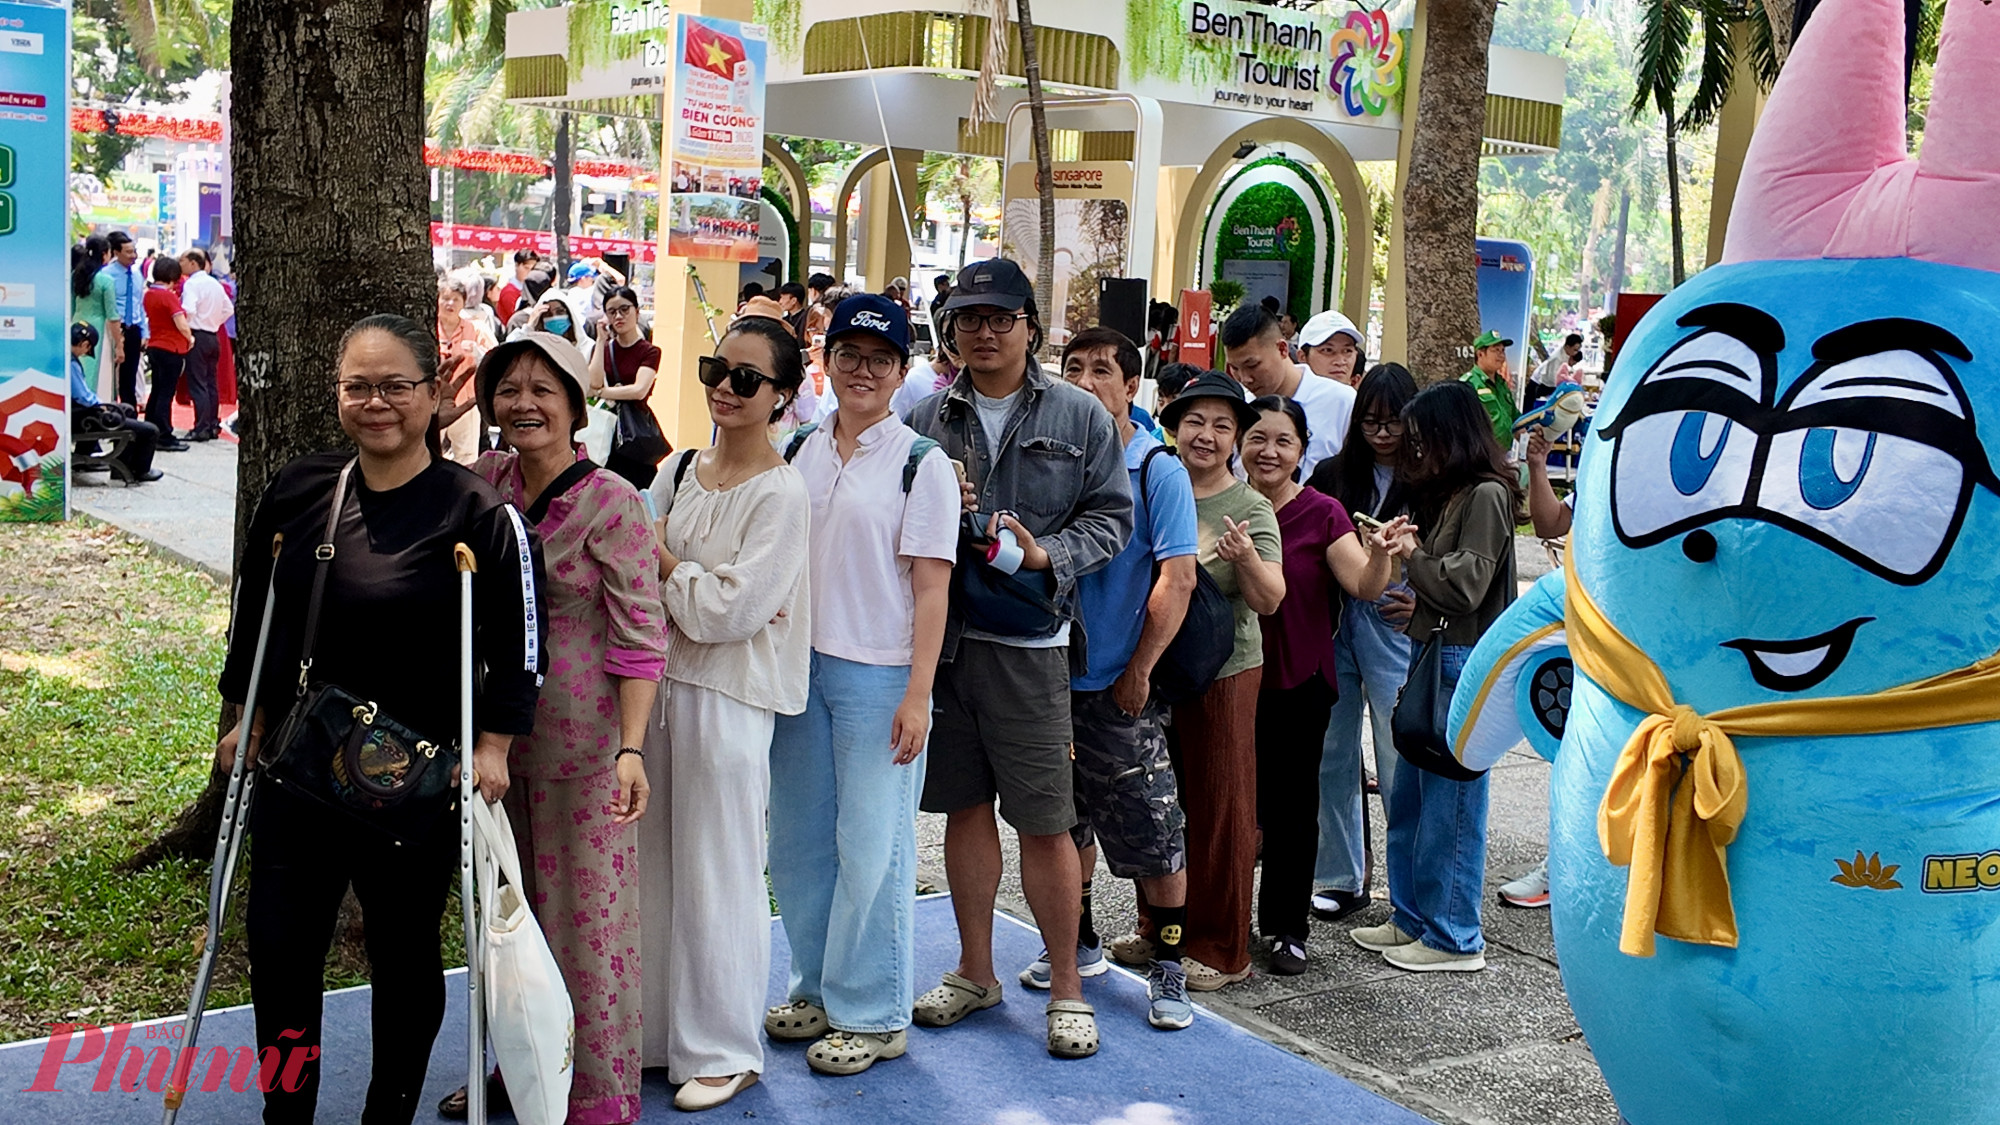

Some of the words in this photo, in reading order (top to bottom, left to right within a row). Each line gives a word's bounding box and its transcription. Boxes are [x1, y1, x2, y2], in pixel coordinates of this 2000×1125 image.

[610, 0, 668, 33] BenTha
[1192, 2, 1322, 52] BenThanh
[1239, 52, 1320, 92] Tourist
[1214, 88, 1250, 104] journey
[1254, 92, 1263, 105] to
[1265, 95, 1285, 109] your
[1289, 98, 1314, 112] heart
[1233, 225, 1275, 236] BenThanh
[1247, 236, 1274, 247] Tourist
[851, 310, 891, 331] Ford
